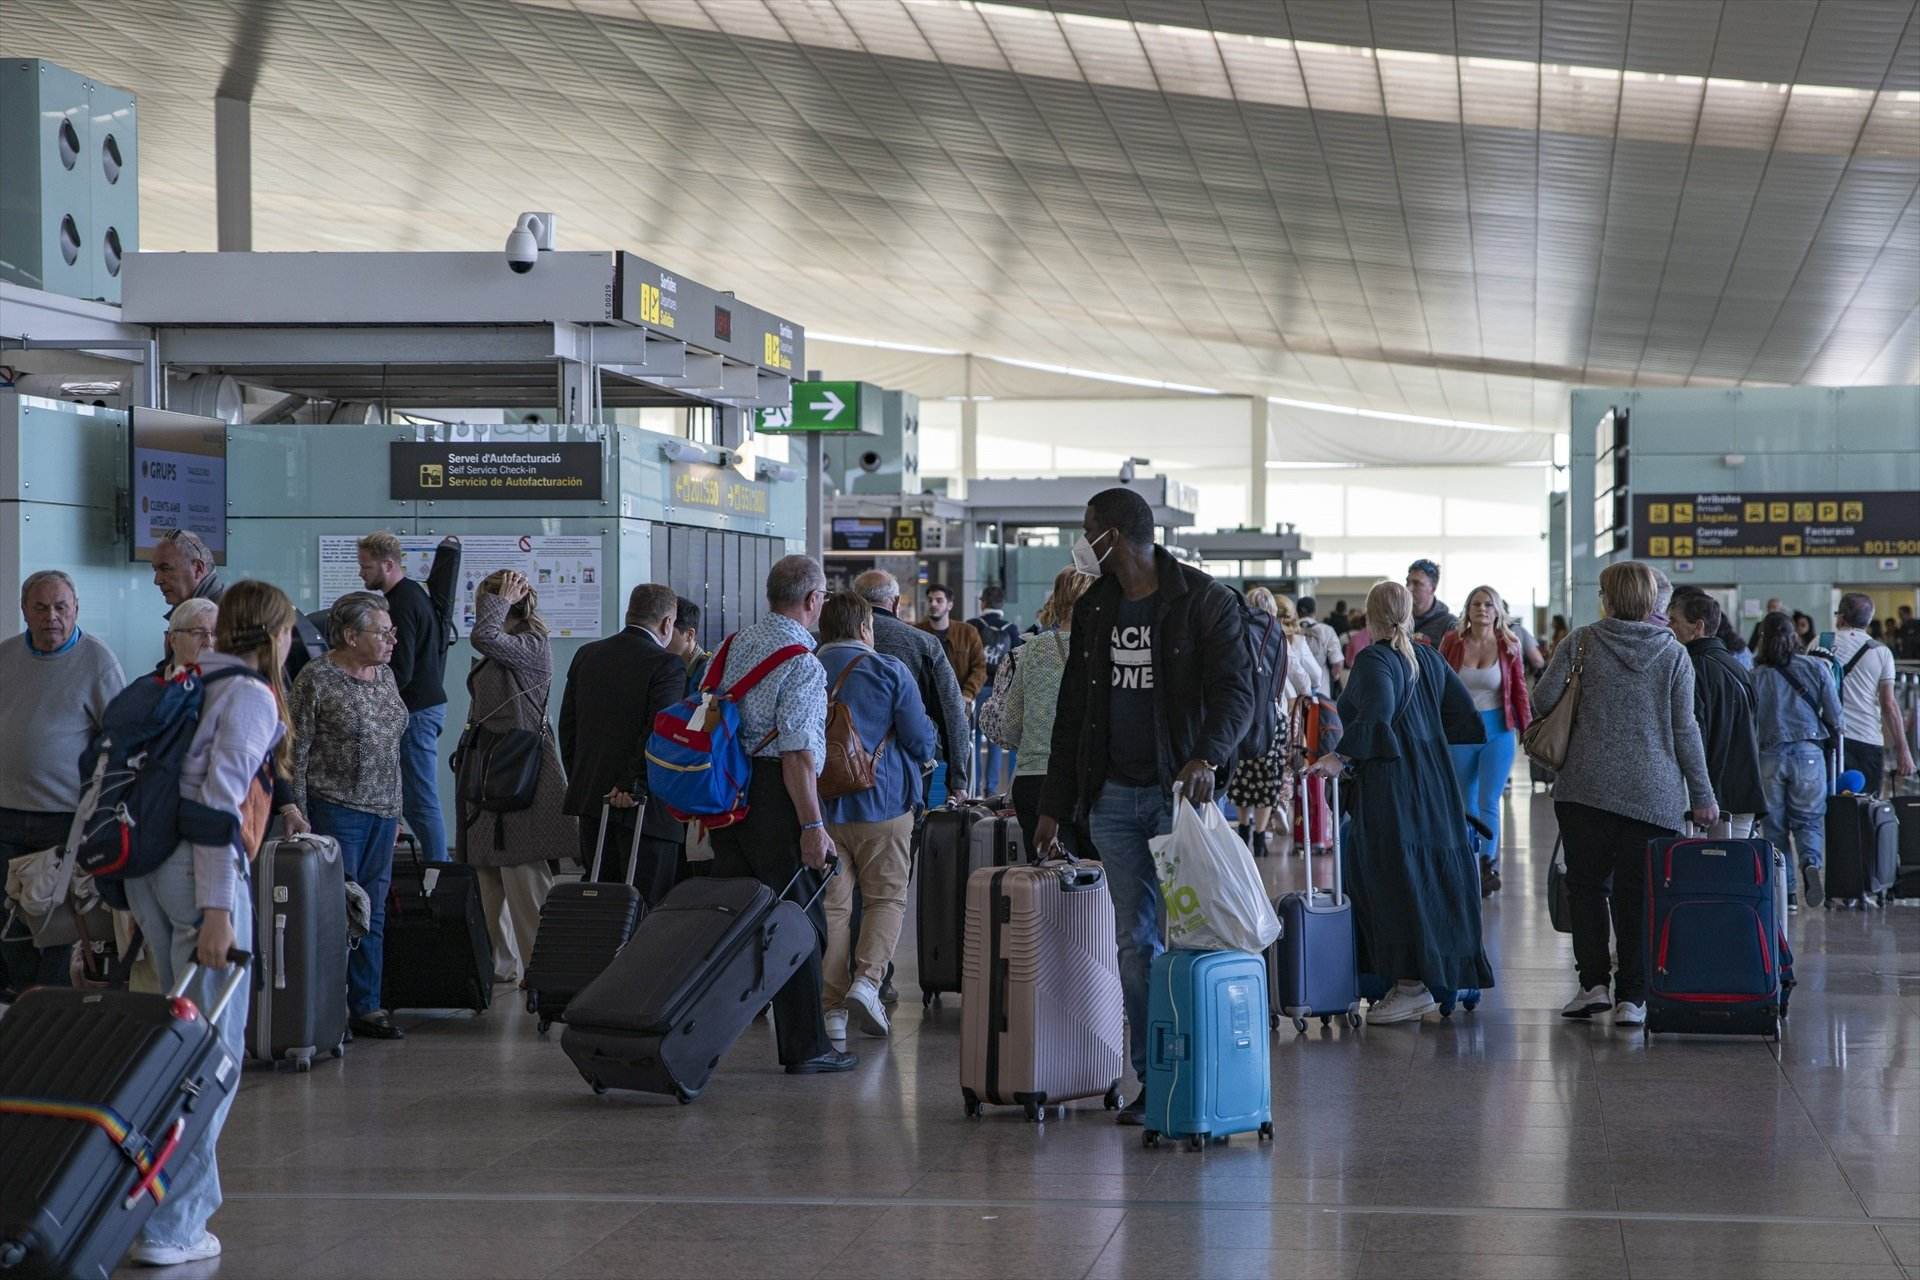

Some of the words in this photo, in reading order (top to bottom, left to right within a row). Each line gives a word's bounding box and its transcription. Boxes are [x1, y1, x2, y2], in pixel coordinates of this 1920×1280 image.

[448, 453, 479, 463] Servei
[481, 453, 561, 463] d'Autofacturació
[150, 461, 177, 481] GRUPS
[448, 465, 465, 474] Self
[467, 465, 498, 474] Service
[500, 465, 536, 474] Check-in
[448, 477, 488, 487] Servicio
[490, 477, 502, 487] de
[506, 477, 583, 487] Autofacturación
[1697, 495, 1741, 504] Arribades
[1697, 527, 1739, 536] Corredor
[892, 537, 917, 550] 601
